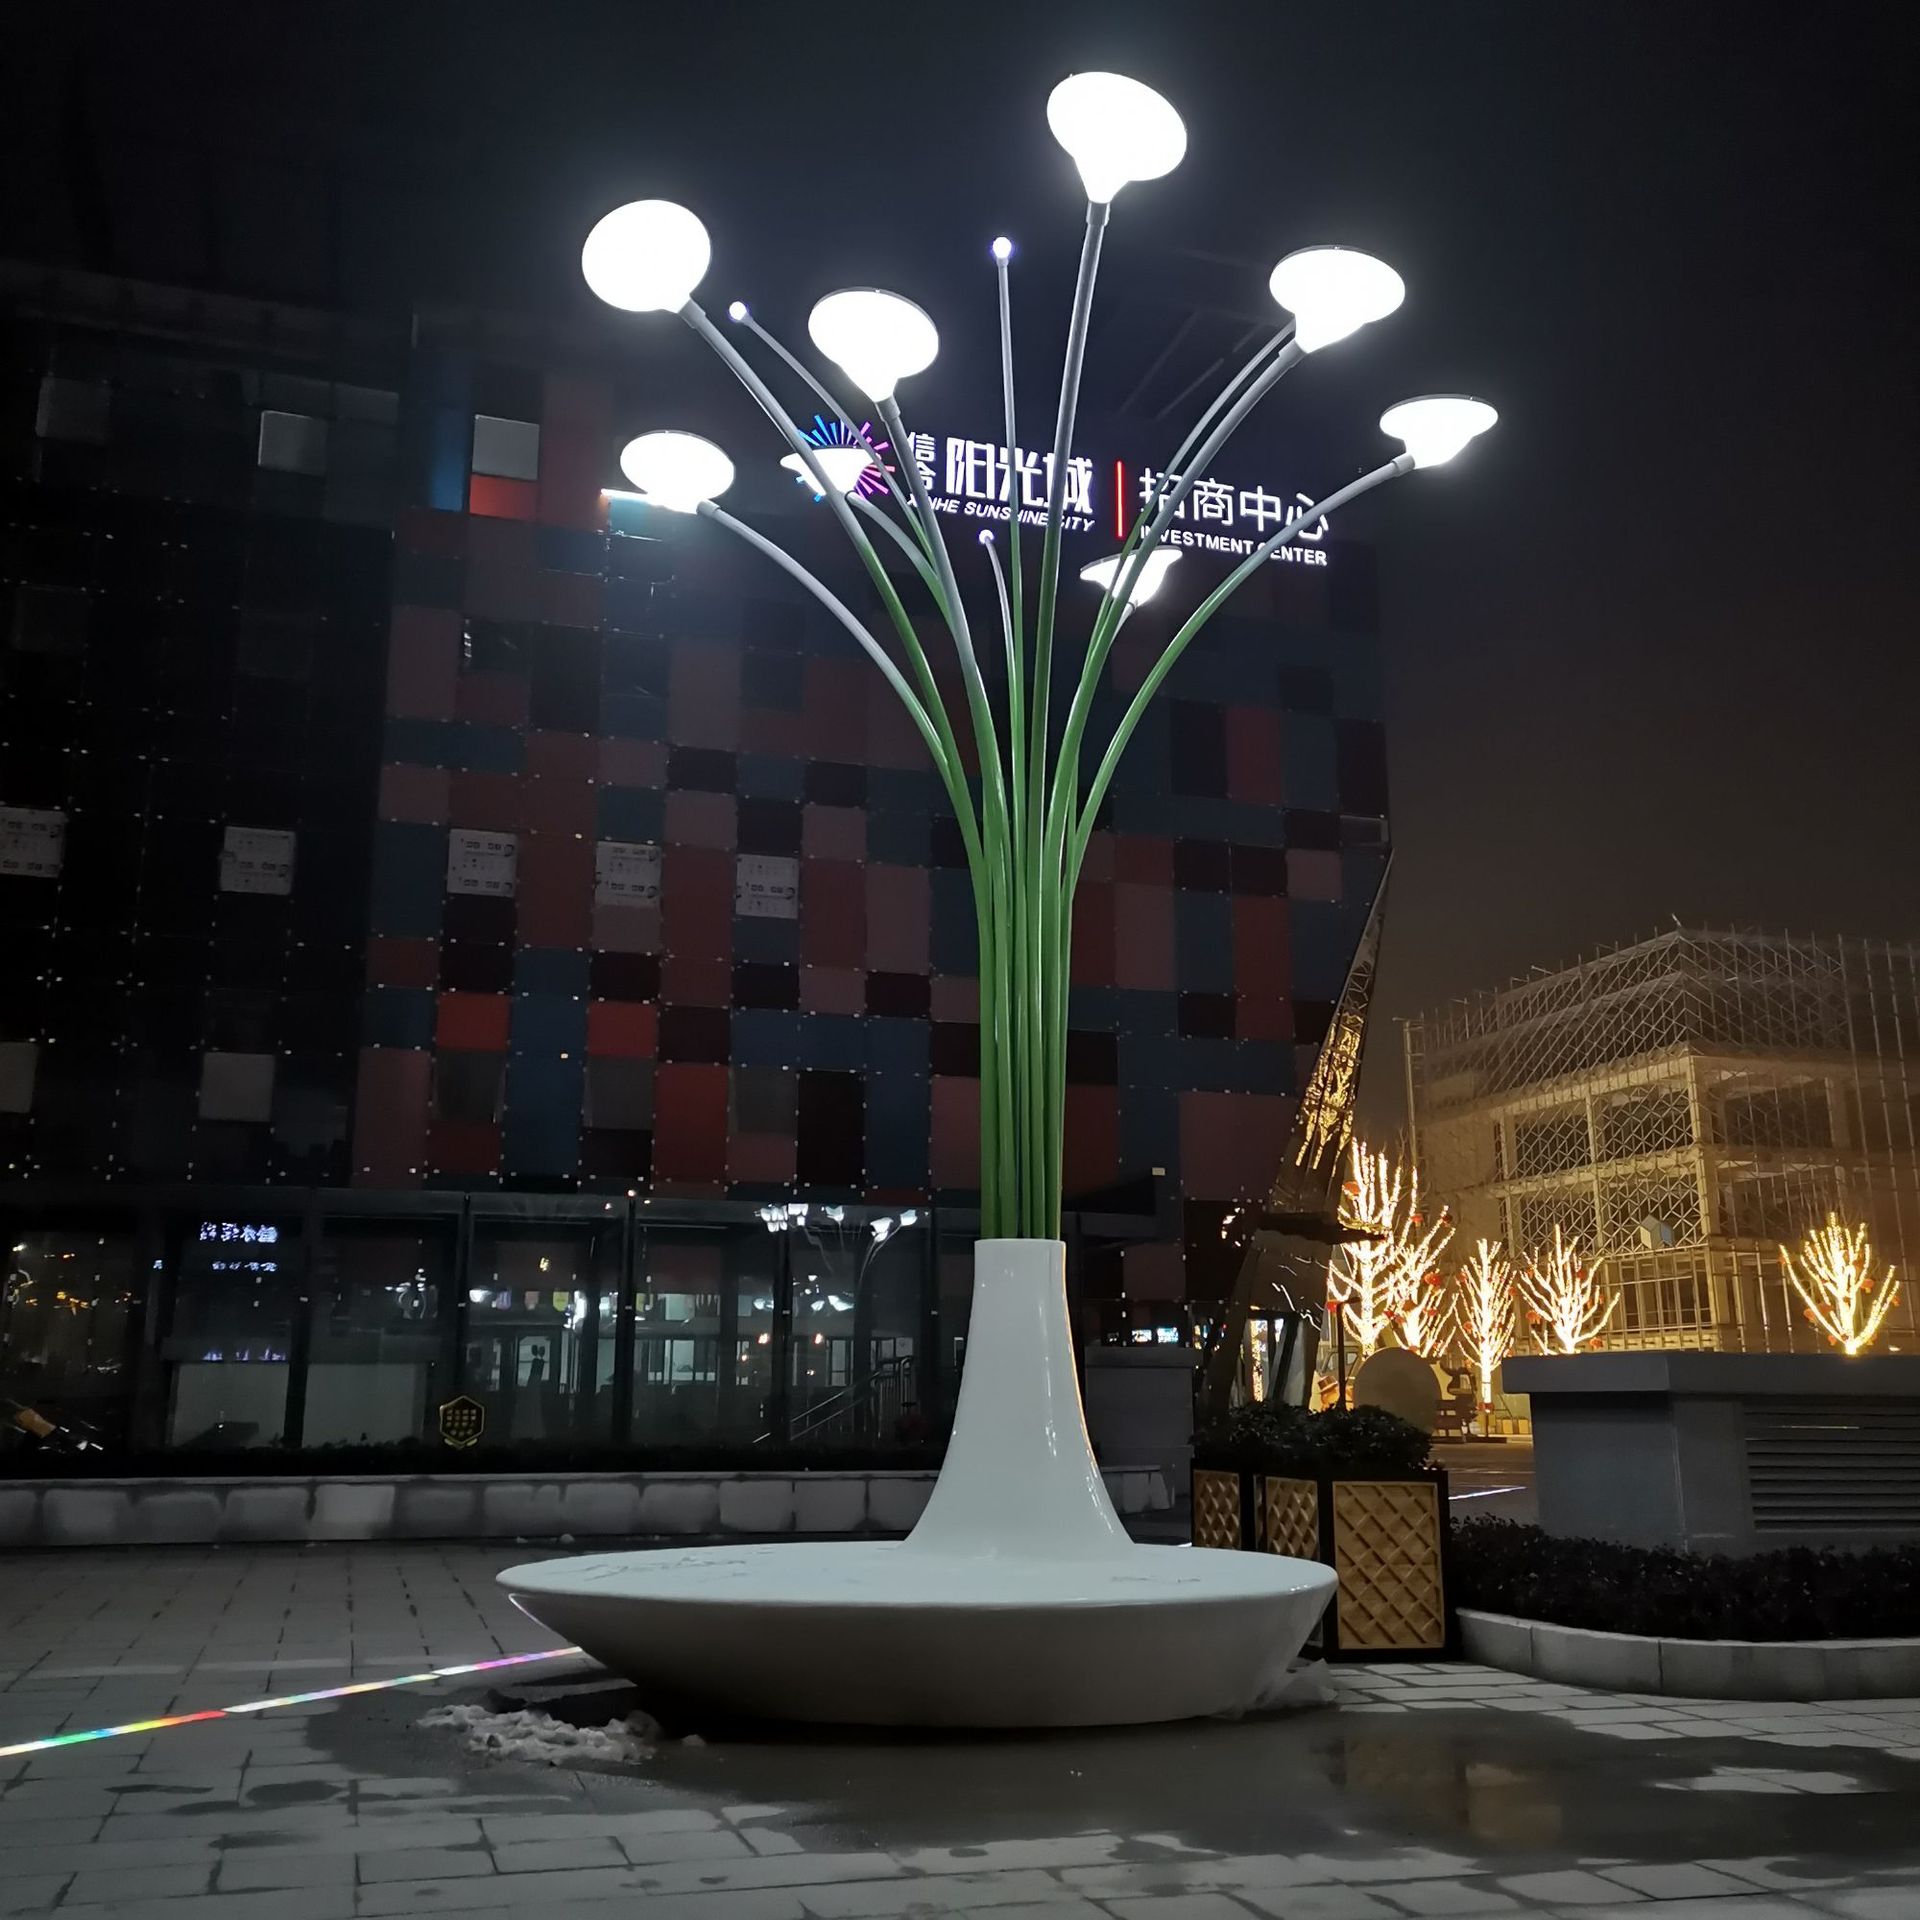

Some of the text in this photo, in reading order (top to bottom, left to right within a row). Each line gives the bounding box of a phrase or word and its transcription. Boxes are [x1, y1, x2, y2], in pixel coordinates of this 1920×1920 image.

[907, 493, 960, 513] XNHE
[946, 437, 1094, 514] 阳光城
[1139, 468, 1329, 540] 招商中心
